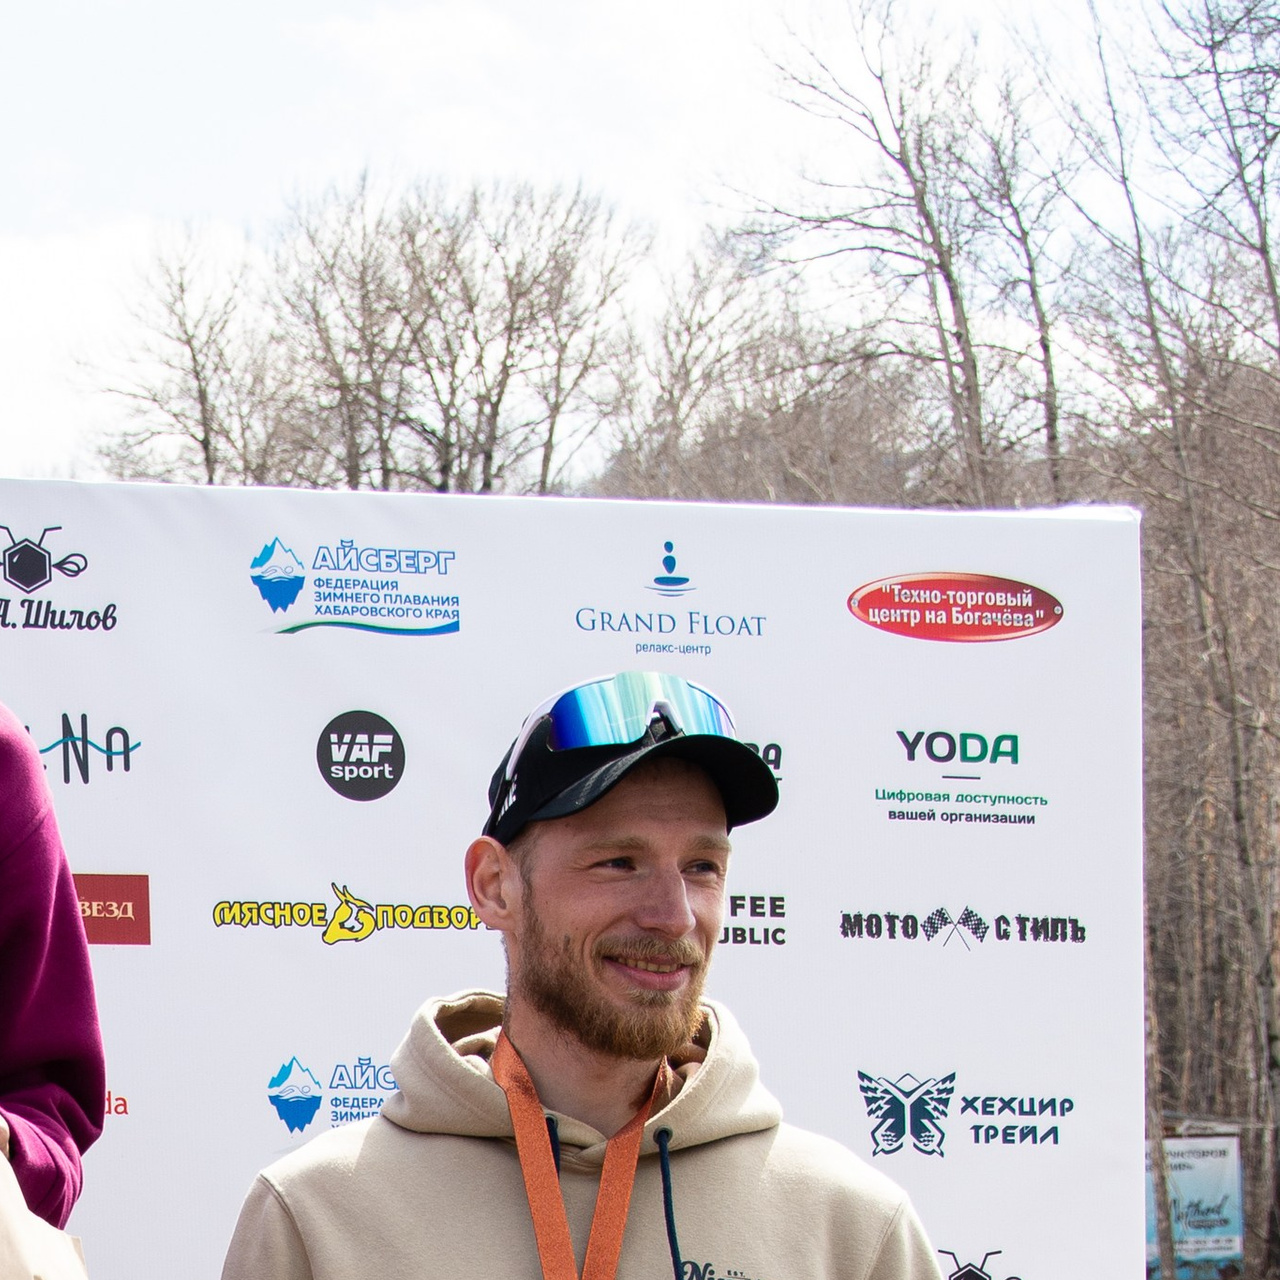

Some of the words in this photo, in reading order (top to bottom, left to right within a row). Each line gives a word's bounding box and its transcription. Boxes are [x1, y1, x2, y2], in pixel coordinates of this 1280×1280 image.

[312, 539, 455, 575] АЙСБЕРГ
[313, 577, 398, 592] ФЕДЕРАЦИЯ
[314, 592, 380, 604] ЗИМНЕГО
[384, 594, 459, 606] ПЛАВАНИЯ
[881, 584, 1032, 607] "Техно-торговый
[314, 605, 422, 618] ХАБАРОВСКОГО
[425, 609, 459, 620] КРАЯ
[868, 608, 920, 627] центр
[925, 610, 946, 624] на
[952, 608, 1044, 627] Богачёва"
[635, 643, 711, 656] релакс-центр
[330, 734, 393, 762] VAF
[896, 731, 1019, 764] YODA
[330, 763, 394, 781] sport
[875, 789, 950, 803] Цифровая
[955, 792, 1048, 806] доступность
[888, 809, 936, 821] вашей
[941, 810, 1035, 824] организации
[213, 901, 327, 928] МЯСНОЕ
[375, 904, 492, 930] ПОДВОР
[839, 911, 918, 940] МОТО
[994, 912, 1086, 943] СТИЛЬ
[961, 1096, 1075, 1117] ХЕХЦИР
[970, 1124, 1060, 1145] ТРЕЙЛ
[727, 1270, 746, 1278] EST.
